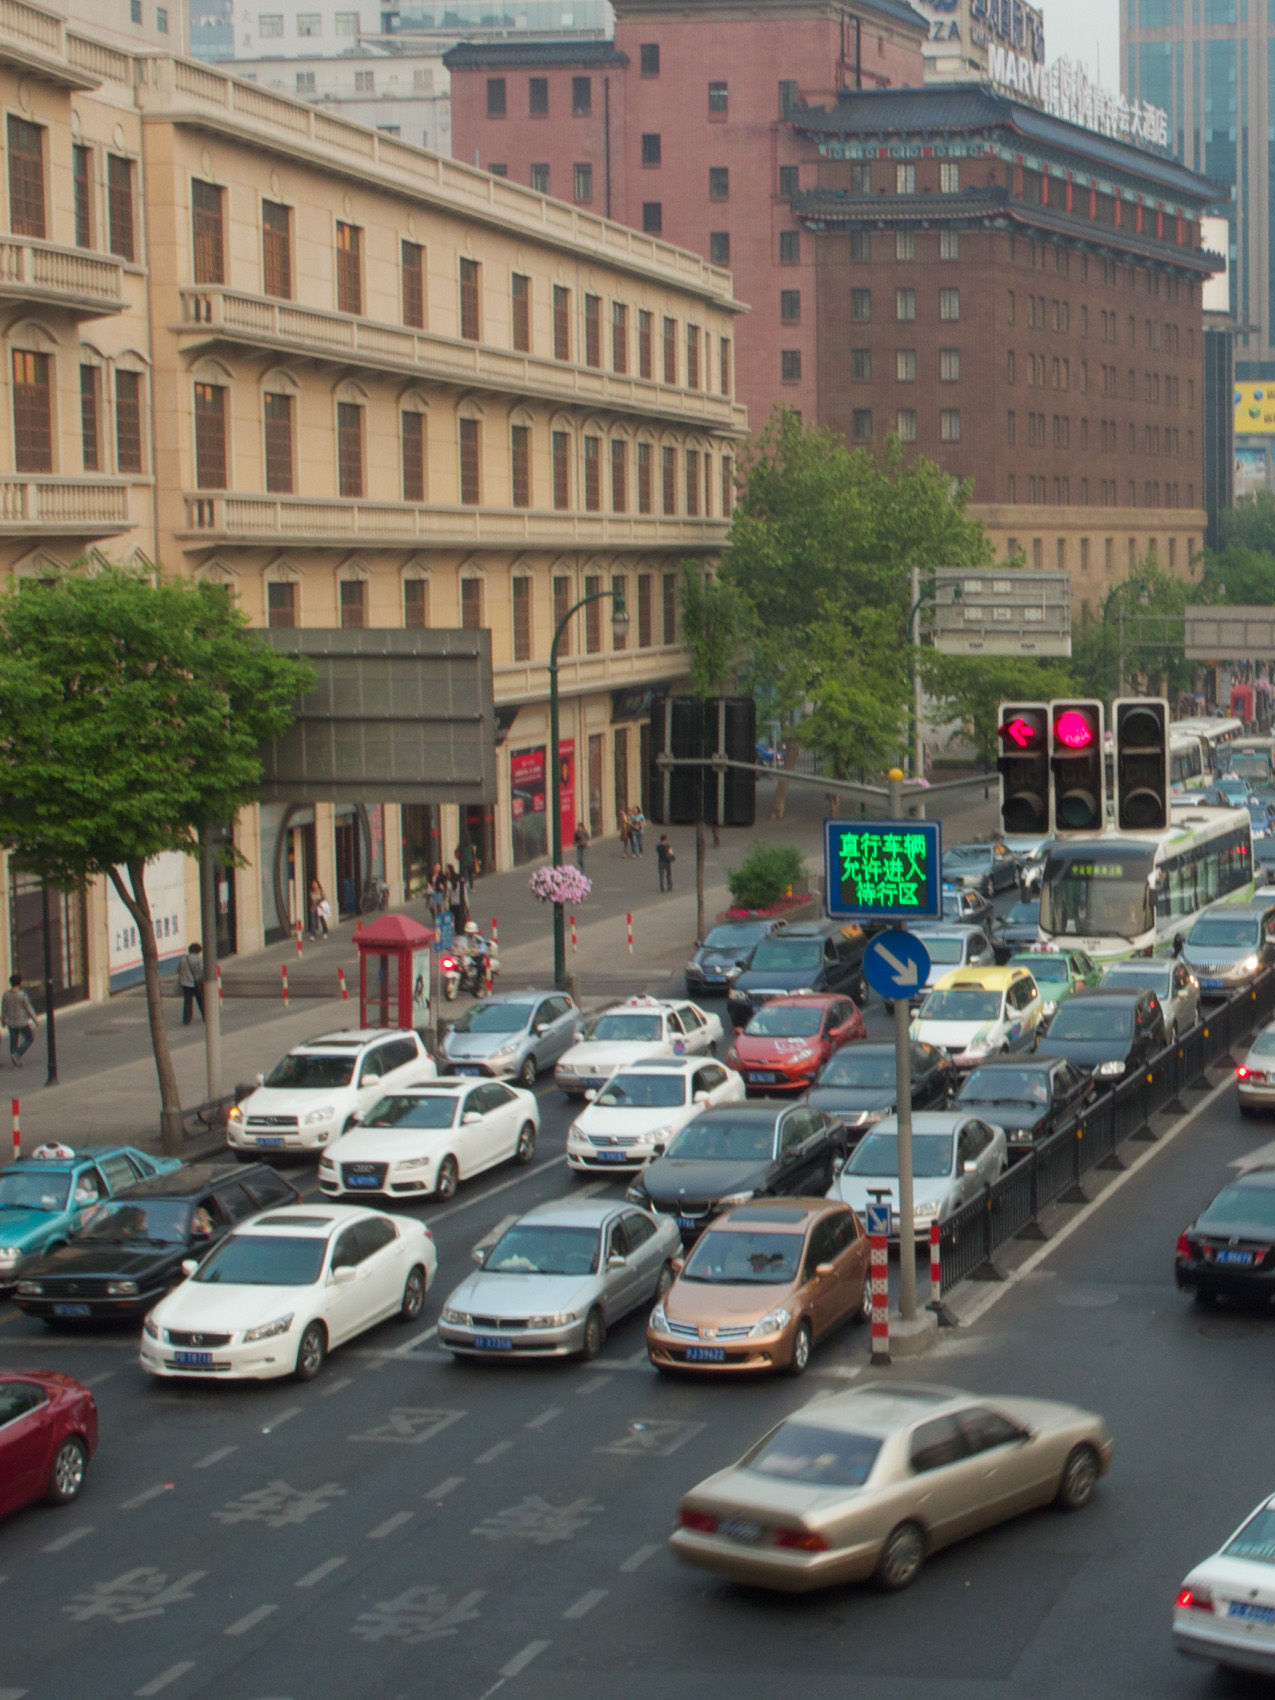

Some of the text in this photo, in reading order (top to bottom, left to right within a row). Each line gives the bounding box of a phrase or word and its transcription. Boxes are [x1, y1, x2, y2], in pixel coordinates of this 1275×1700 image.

[839, 832, 927, 860] 直行车辆
[840, 856, 927, 883] 允许进入
[855, 880, 919, 908] 待行区
